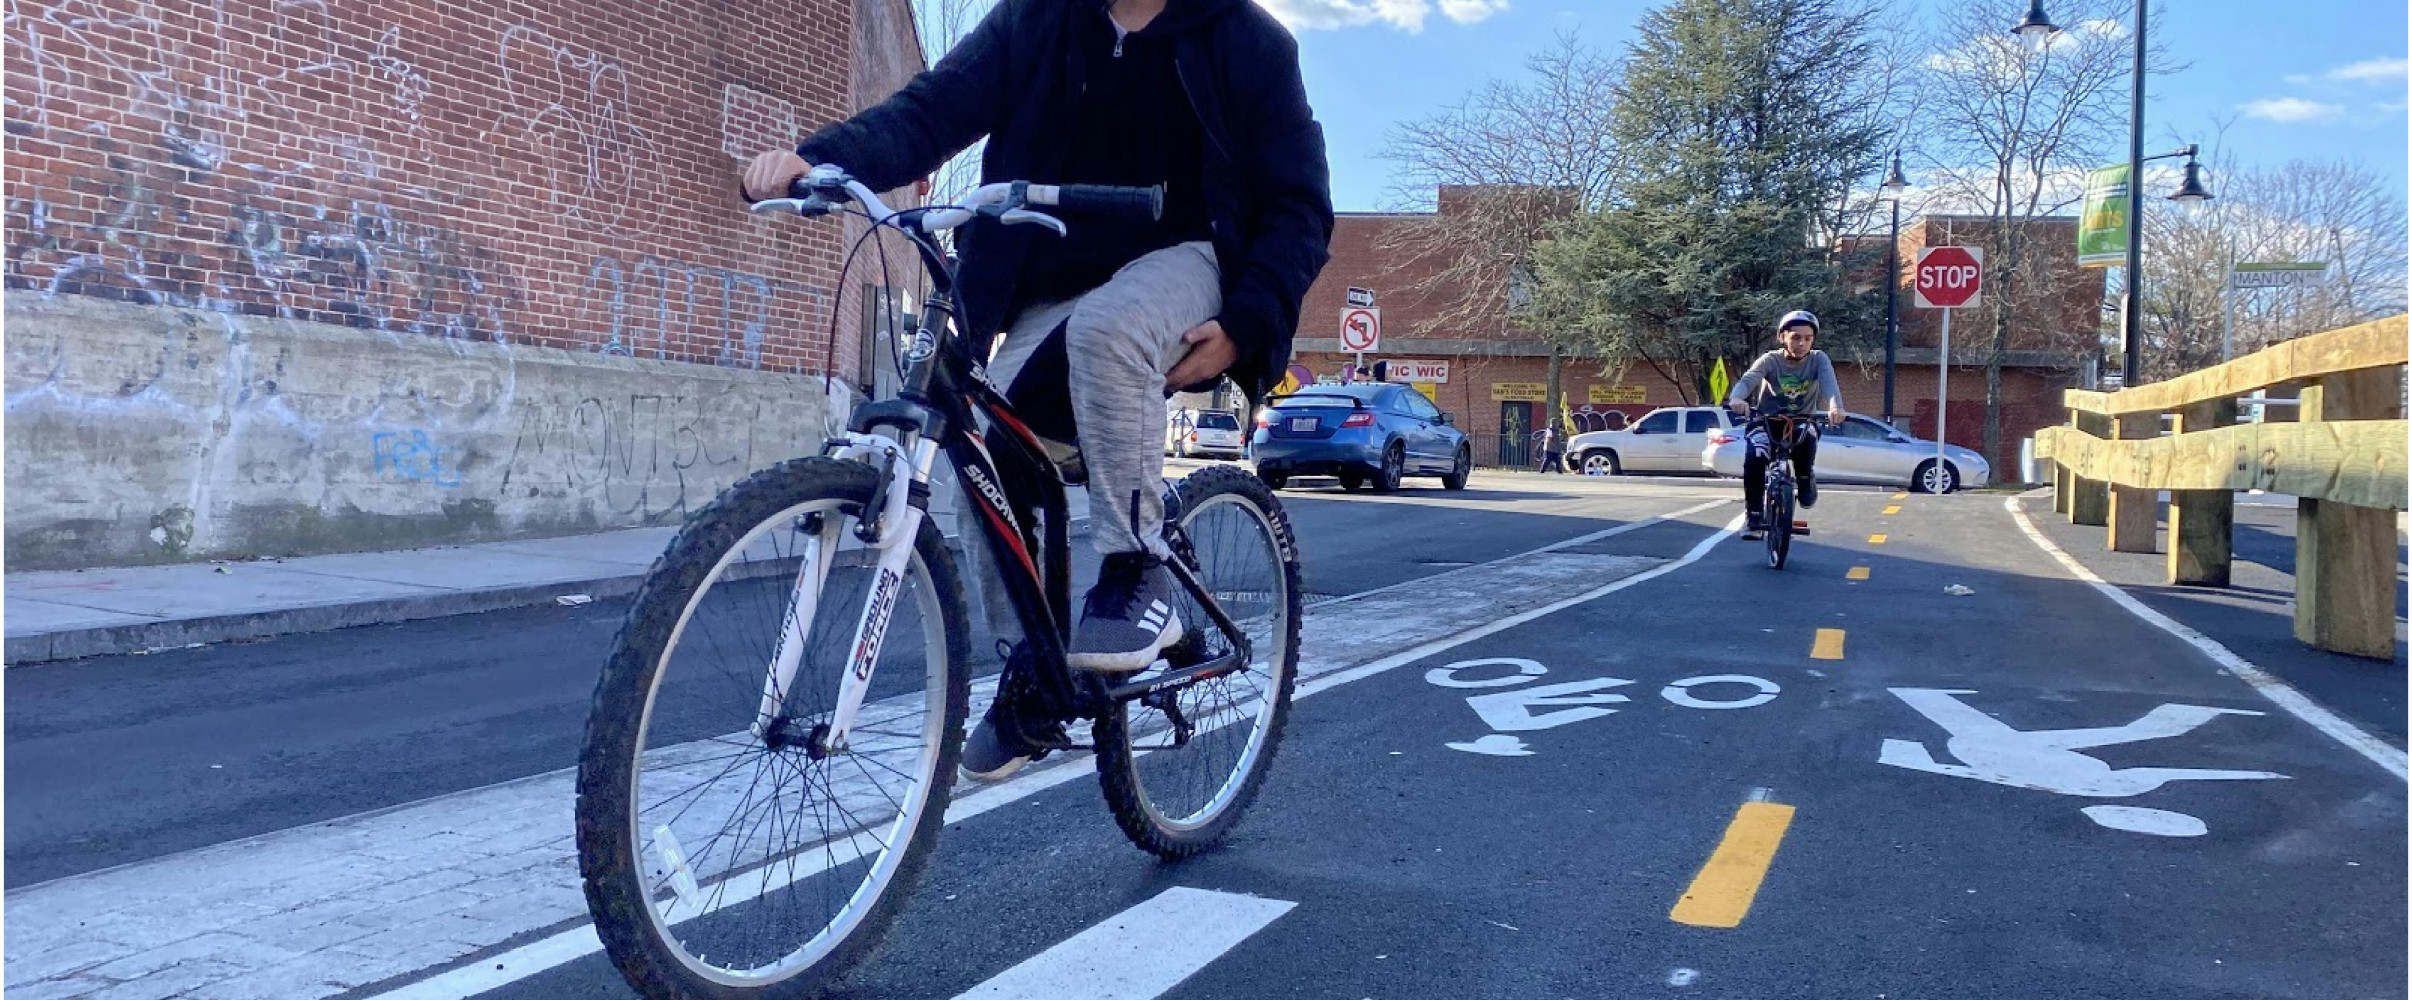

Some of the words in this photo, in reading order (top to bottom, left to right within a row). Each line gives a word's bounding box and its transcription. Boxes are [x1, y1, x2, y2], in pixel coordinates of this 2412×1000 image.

[1920, 265, 1977, 289] STOP
[2239, 272, 2304, 284] MANTON
[1391, 366, 1410, 377] IC
[1417, 366, 1446, 377] WIC
